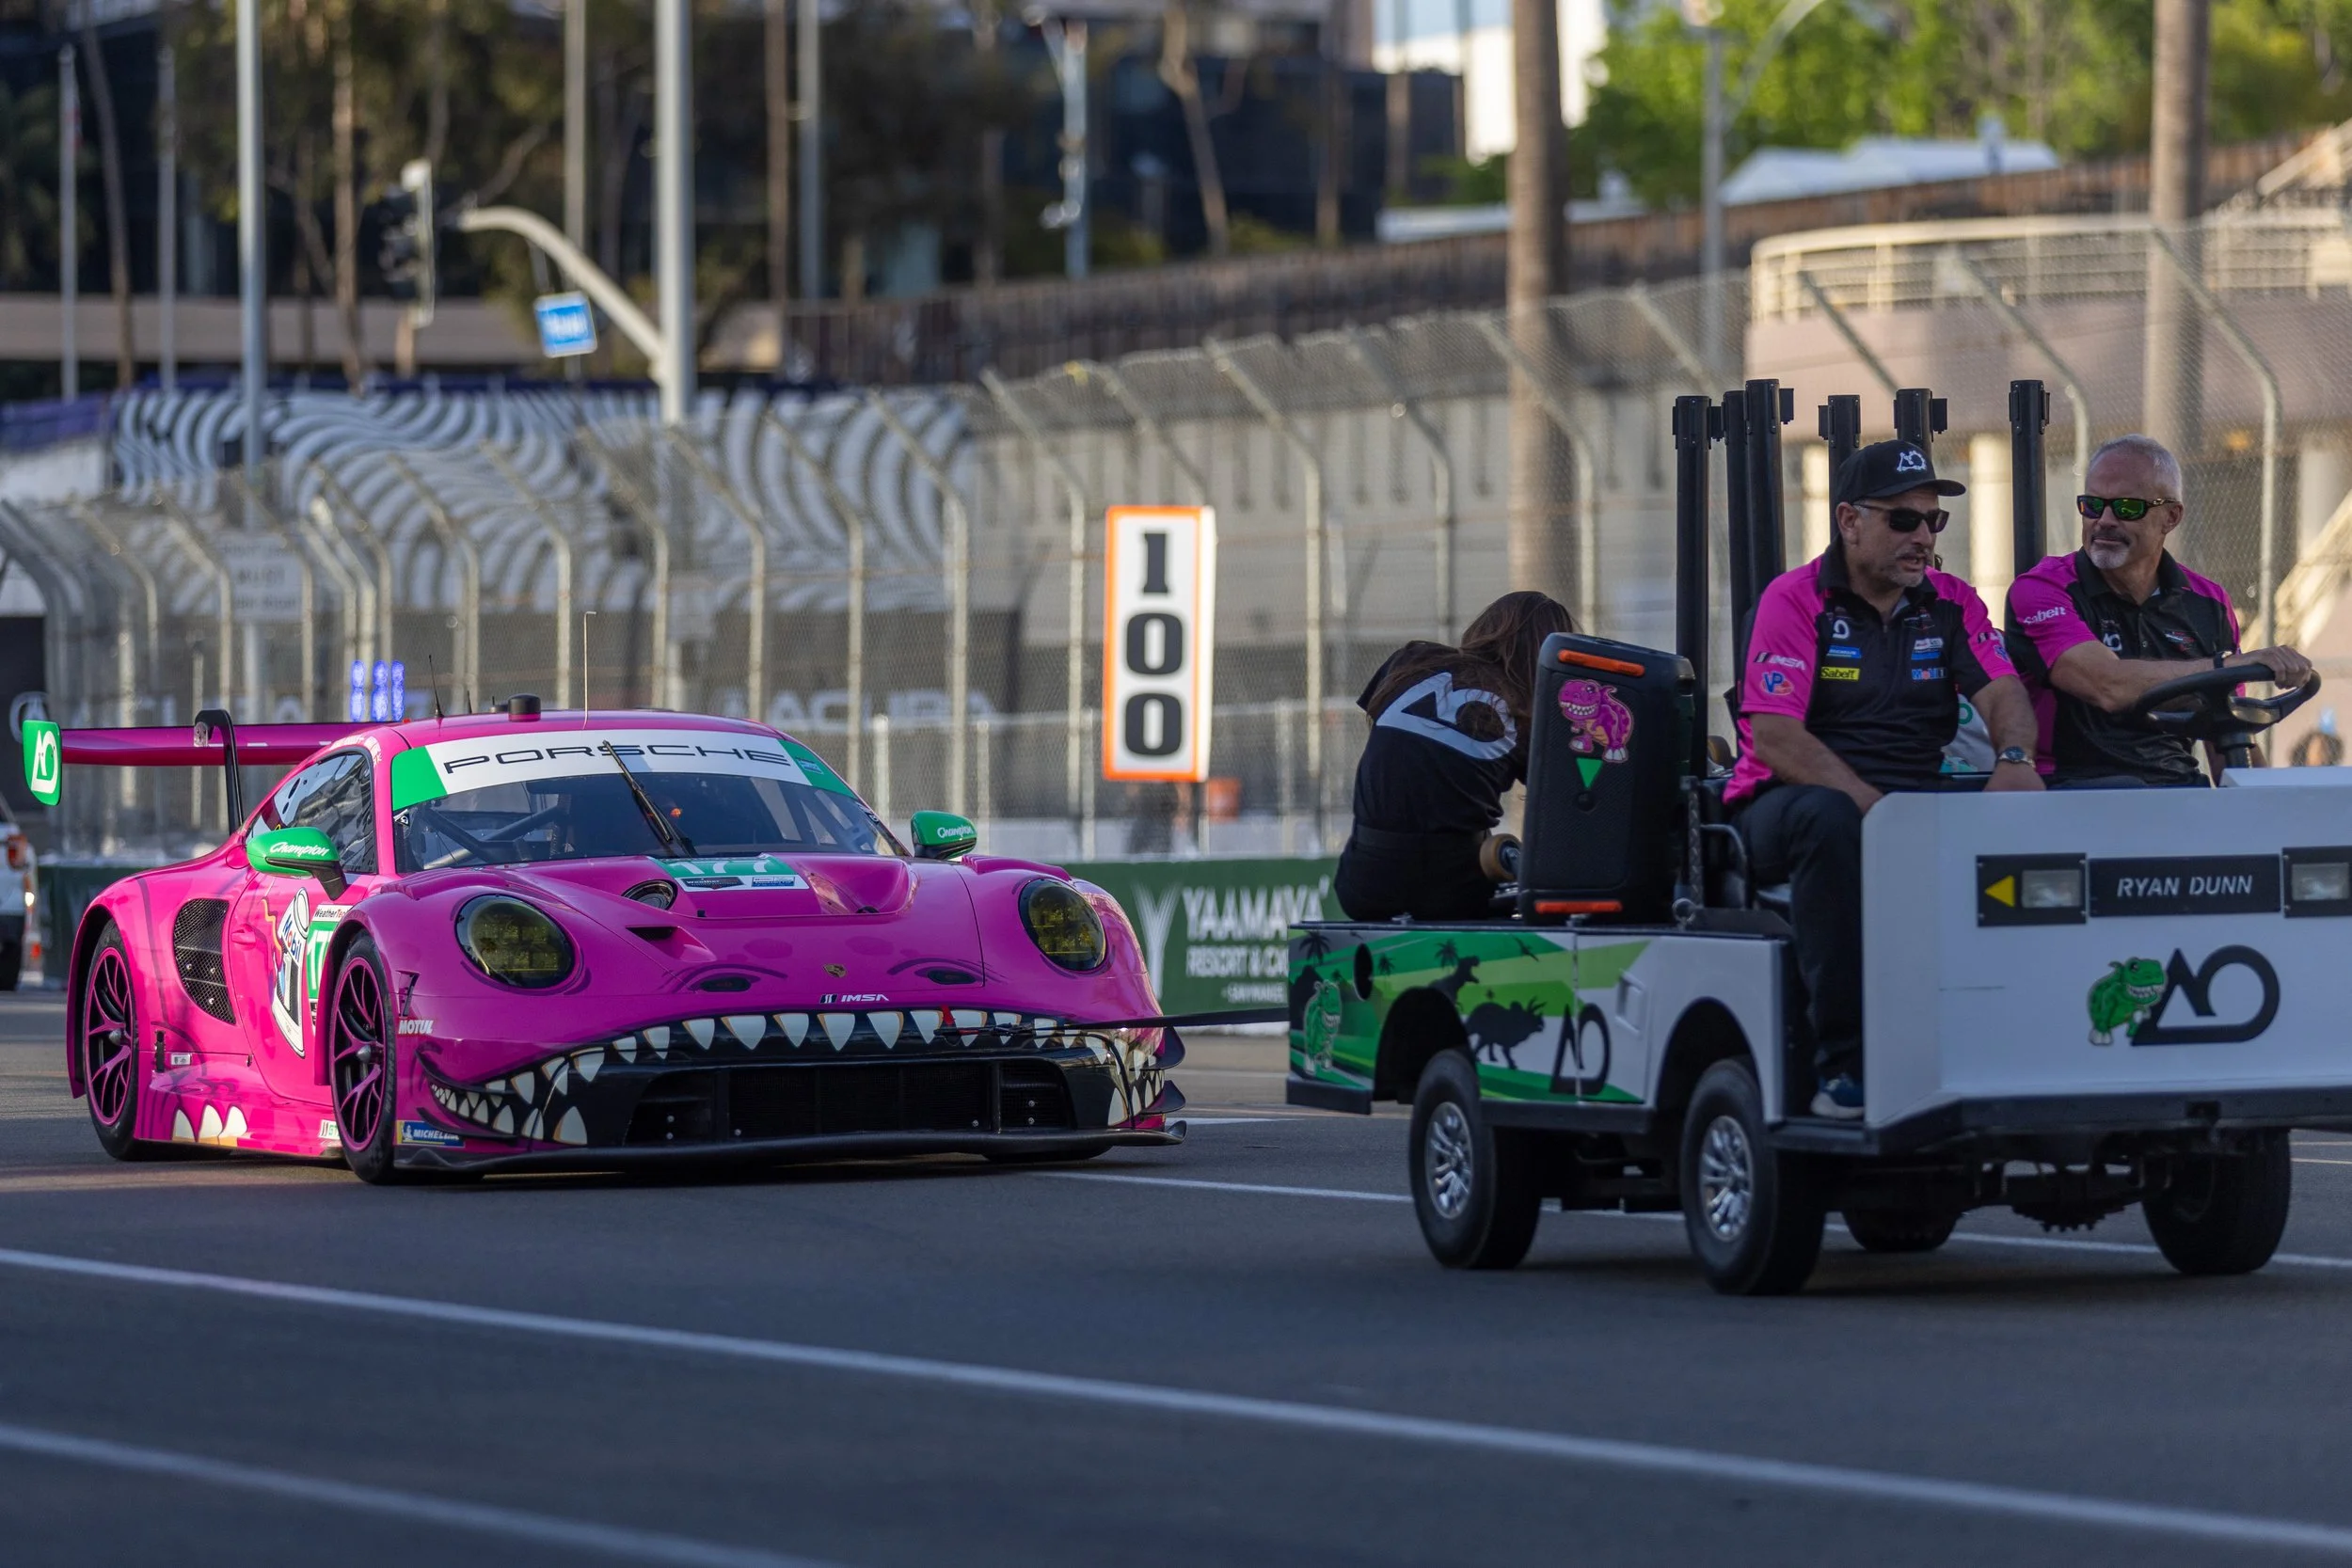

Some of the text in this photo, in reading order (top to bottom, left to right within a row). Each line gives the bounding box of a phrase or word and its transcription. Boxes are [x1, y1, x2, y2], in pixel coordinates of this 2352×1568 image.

[2024, 607, 2066, 625] Sabelt
[1125, 532, 1183, 756] 100
[443, 743, 792, 775] PORSCHE
[936, 824, 975, 839] Champion
[269, 841, 330, 858] Champion
[2117, 874, 2253, 898] RYAN DUNN
[281, 912, 303, 963] Mobil
[1185, 944, 1247, 978] RESORT
[840, 993, 890, 1003] IMSA
[398, 1020, 434, 1035] MOTUL
